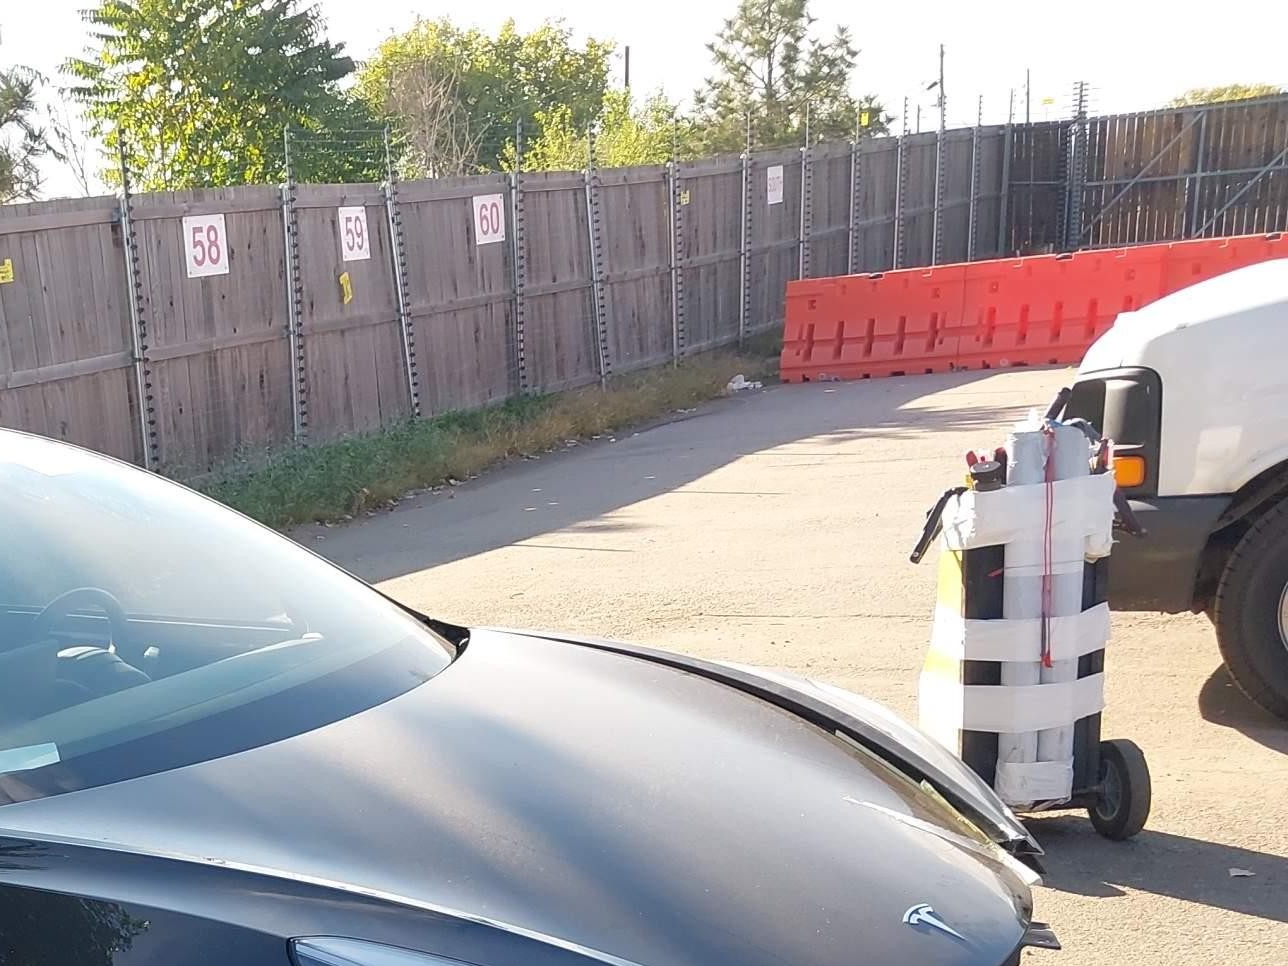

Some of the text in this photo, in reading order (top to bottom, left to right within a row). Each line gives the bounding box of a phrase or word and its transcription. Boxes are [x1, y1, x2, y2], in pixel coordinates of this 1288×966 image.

[344, 215, 365, 252] 59
[478, 201, 501, 236] 60
[192, 224, 221, 267] 58
